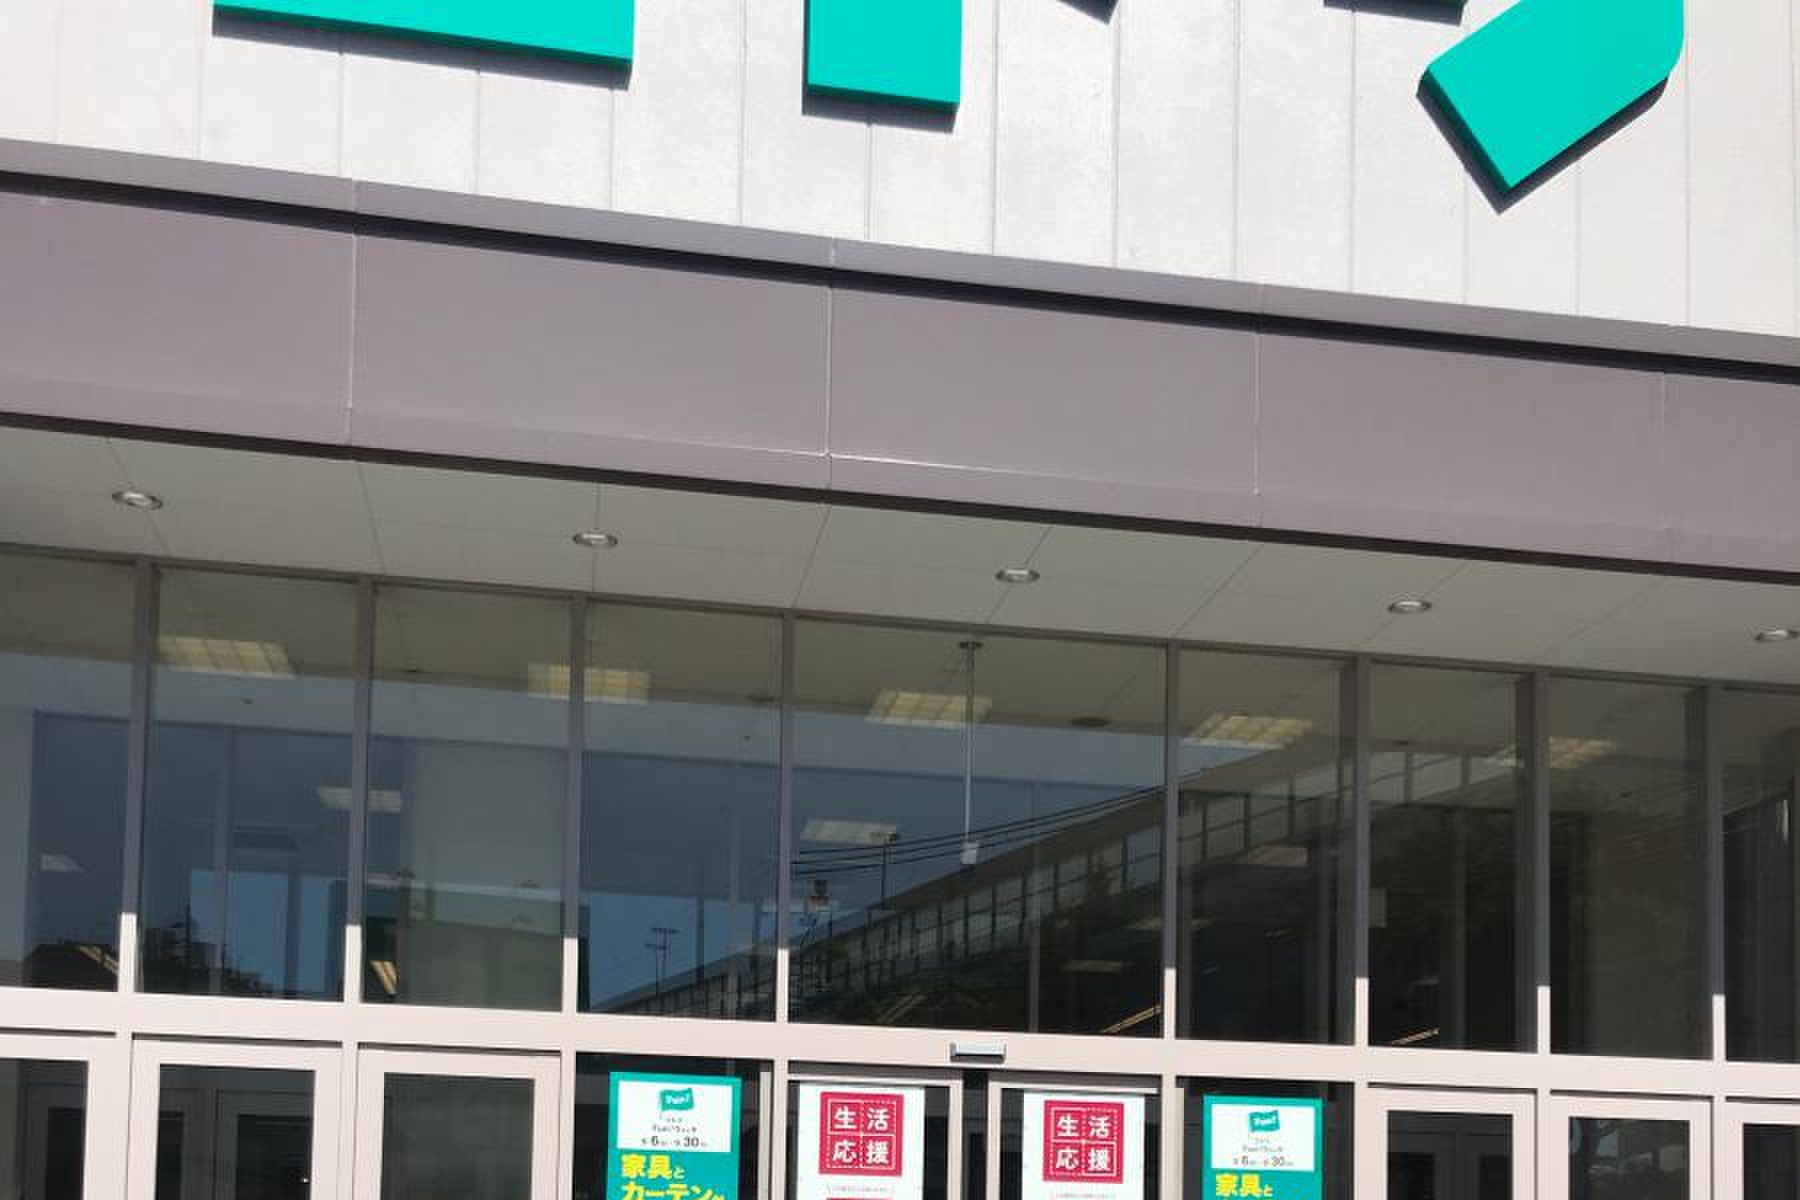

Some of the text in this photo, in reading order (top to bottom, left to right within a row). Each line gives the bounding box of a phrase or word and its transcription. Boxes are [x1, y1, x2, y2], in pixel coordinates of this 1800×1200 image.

[833, 1106, 890, 1132] 生活
[1056, 1114, 1112, 1138] 生活
[832, 1140, 890, 1165] 応援
[1055, 1147, 1111, 1172] 応援
[620, 1153, 686, 1179] 家具と
[1215, 1173, 1273, 1198] 家具と
